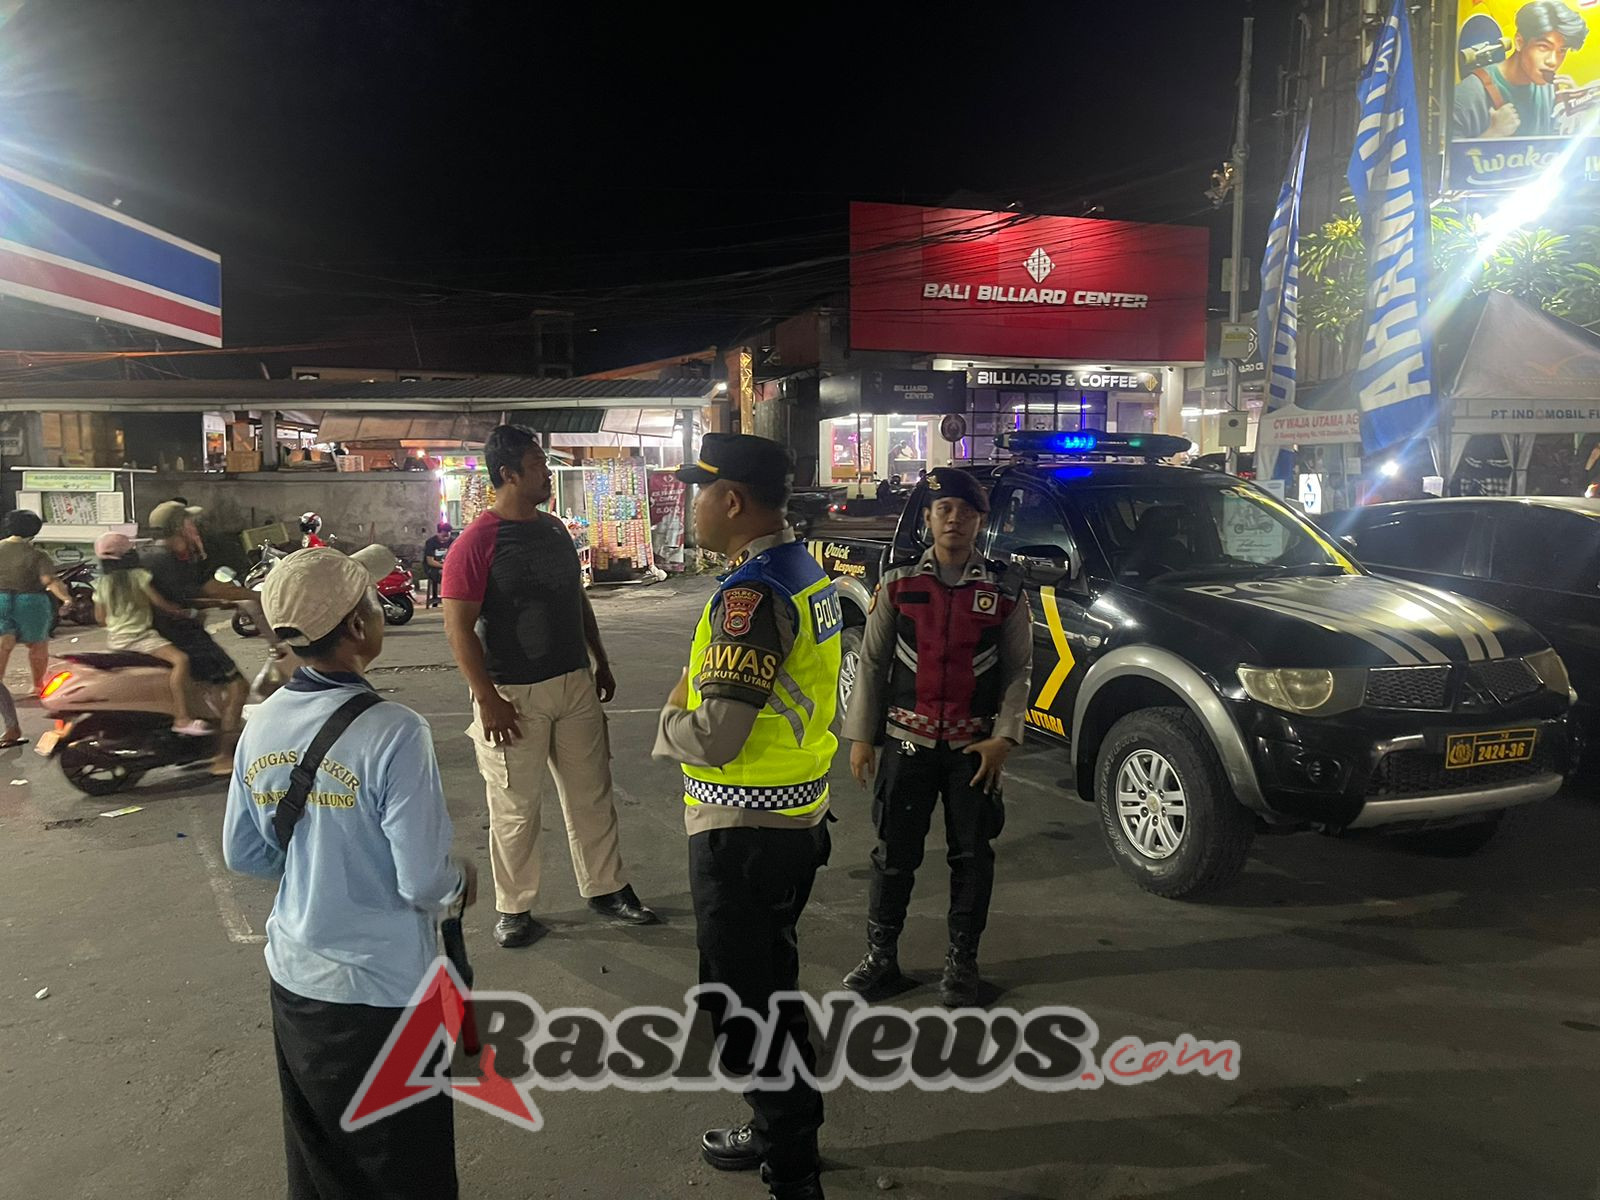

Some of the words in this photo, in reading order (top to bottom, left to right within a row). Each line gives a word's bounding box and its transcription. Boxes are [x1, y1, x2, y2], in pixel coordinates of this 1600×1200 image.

[923, 283, 971, 300] BALI
[977, 285, 1067, 305] BILLIARD
[1073, 290, 1149, 309] CENTER
[977, 371, 1061, 386] BILLIARDS
[1065, 374, 1076, 387] &
[1079, 374, 1138, 388] COFFEE
[904, 392, 934, 400] CENTER
[1312, 414, 1343, 428] UTAMA
[1491, 409, 1508, 419] PT
[1512, 408, 1585, 419] INDOMOBIL
[824, 542, 850, 559] Quick
[833, 560, 866, 576] Response
[713, 670, 740, 681] KUTA
[743, 674, 771, 690] UTARA
[1030, 709, 1066, 737] UTARA
[1477, 742, 1526, 761] 2424-36
[243, 750, 298, 789] PETUGAS
